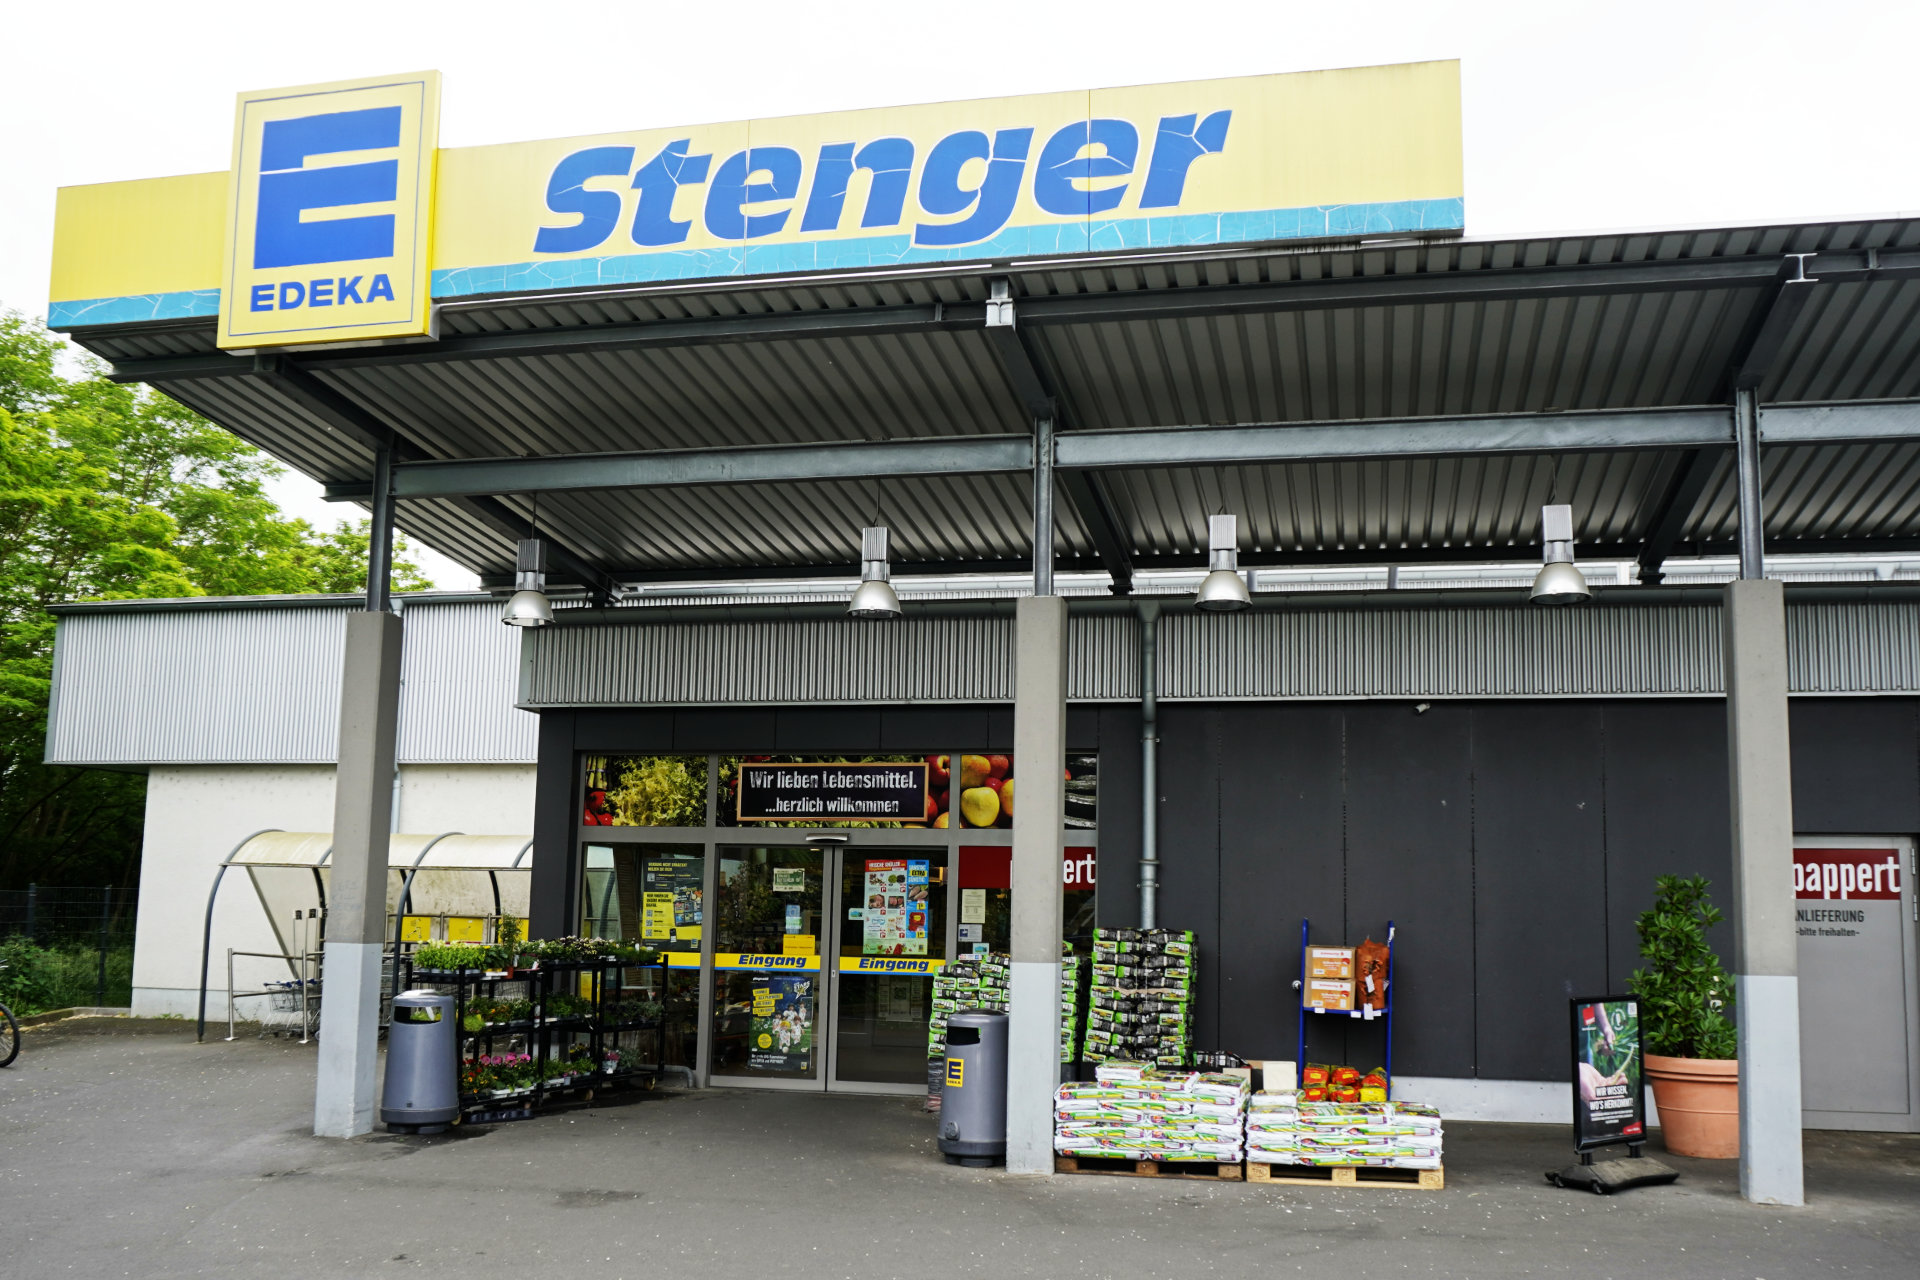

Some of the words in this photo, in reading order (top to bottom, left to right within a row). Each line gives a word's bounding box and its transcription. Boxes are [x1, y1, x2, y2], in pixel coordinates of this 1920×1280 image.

[253, 106, 402, 269] E
[533, 109, 1233, 252] stenger
[250, 273, 395, 312] EDEKA
[749, 770, 774, 789] Wir
[776, 770, 819, 789] lieben
[822, 770, 918, 789] Lebensmittel.
[764, 797, 824, 813] ...herzlich
[826, 797, 900, 813] willkommen
[738, 954, 807, 968] Eingang
[858, 957, 930, 972] Eingang
